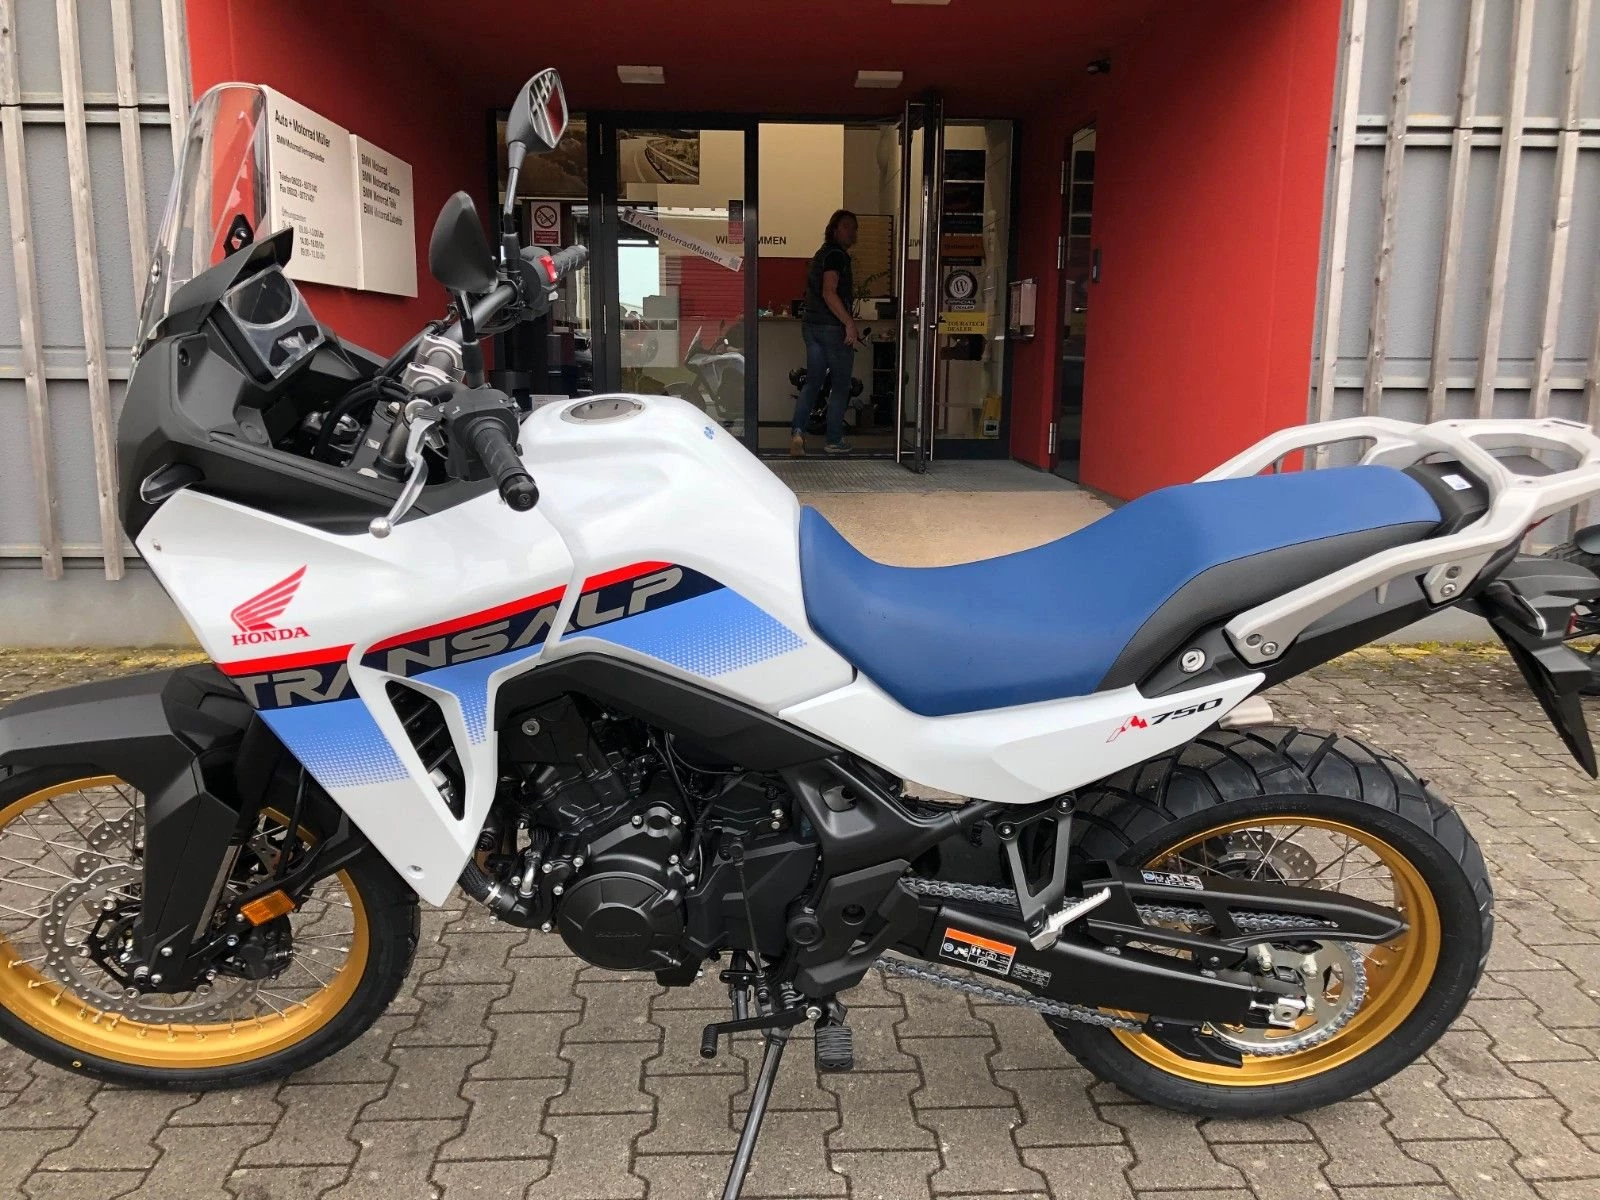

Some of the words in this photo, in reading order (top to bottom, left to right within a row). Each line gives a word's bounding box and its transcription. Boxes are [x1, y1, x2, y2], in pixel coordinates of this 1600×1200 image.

[275, 109, 288, 127] Auto
[293, 118, 315, 140] Motorrad
[316, 130, 330, 147] Müller
[361, 153, 371, 168] BMW
[372, 159, 388, 176] Motorrad
[362, 169, 372, 183] BMW
[373, 174, 389, 191] Motorrad
[363, 186, 372, 200] BMW
[373, 190, 389, 206] Motorrad
[363, 202, 373, 216] BMW
[374, 207, 389, 221] Motorrad
[636, 218, 723, 264] AutoMotorradMueller
[715, 235, 787, 245] WIMMEN
[947, 320, 985, 328] TOURATECH
[232, 625, 310, 647] HONDA
[1151, 697, 1224, 726] 750
